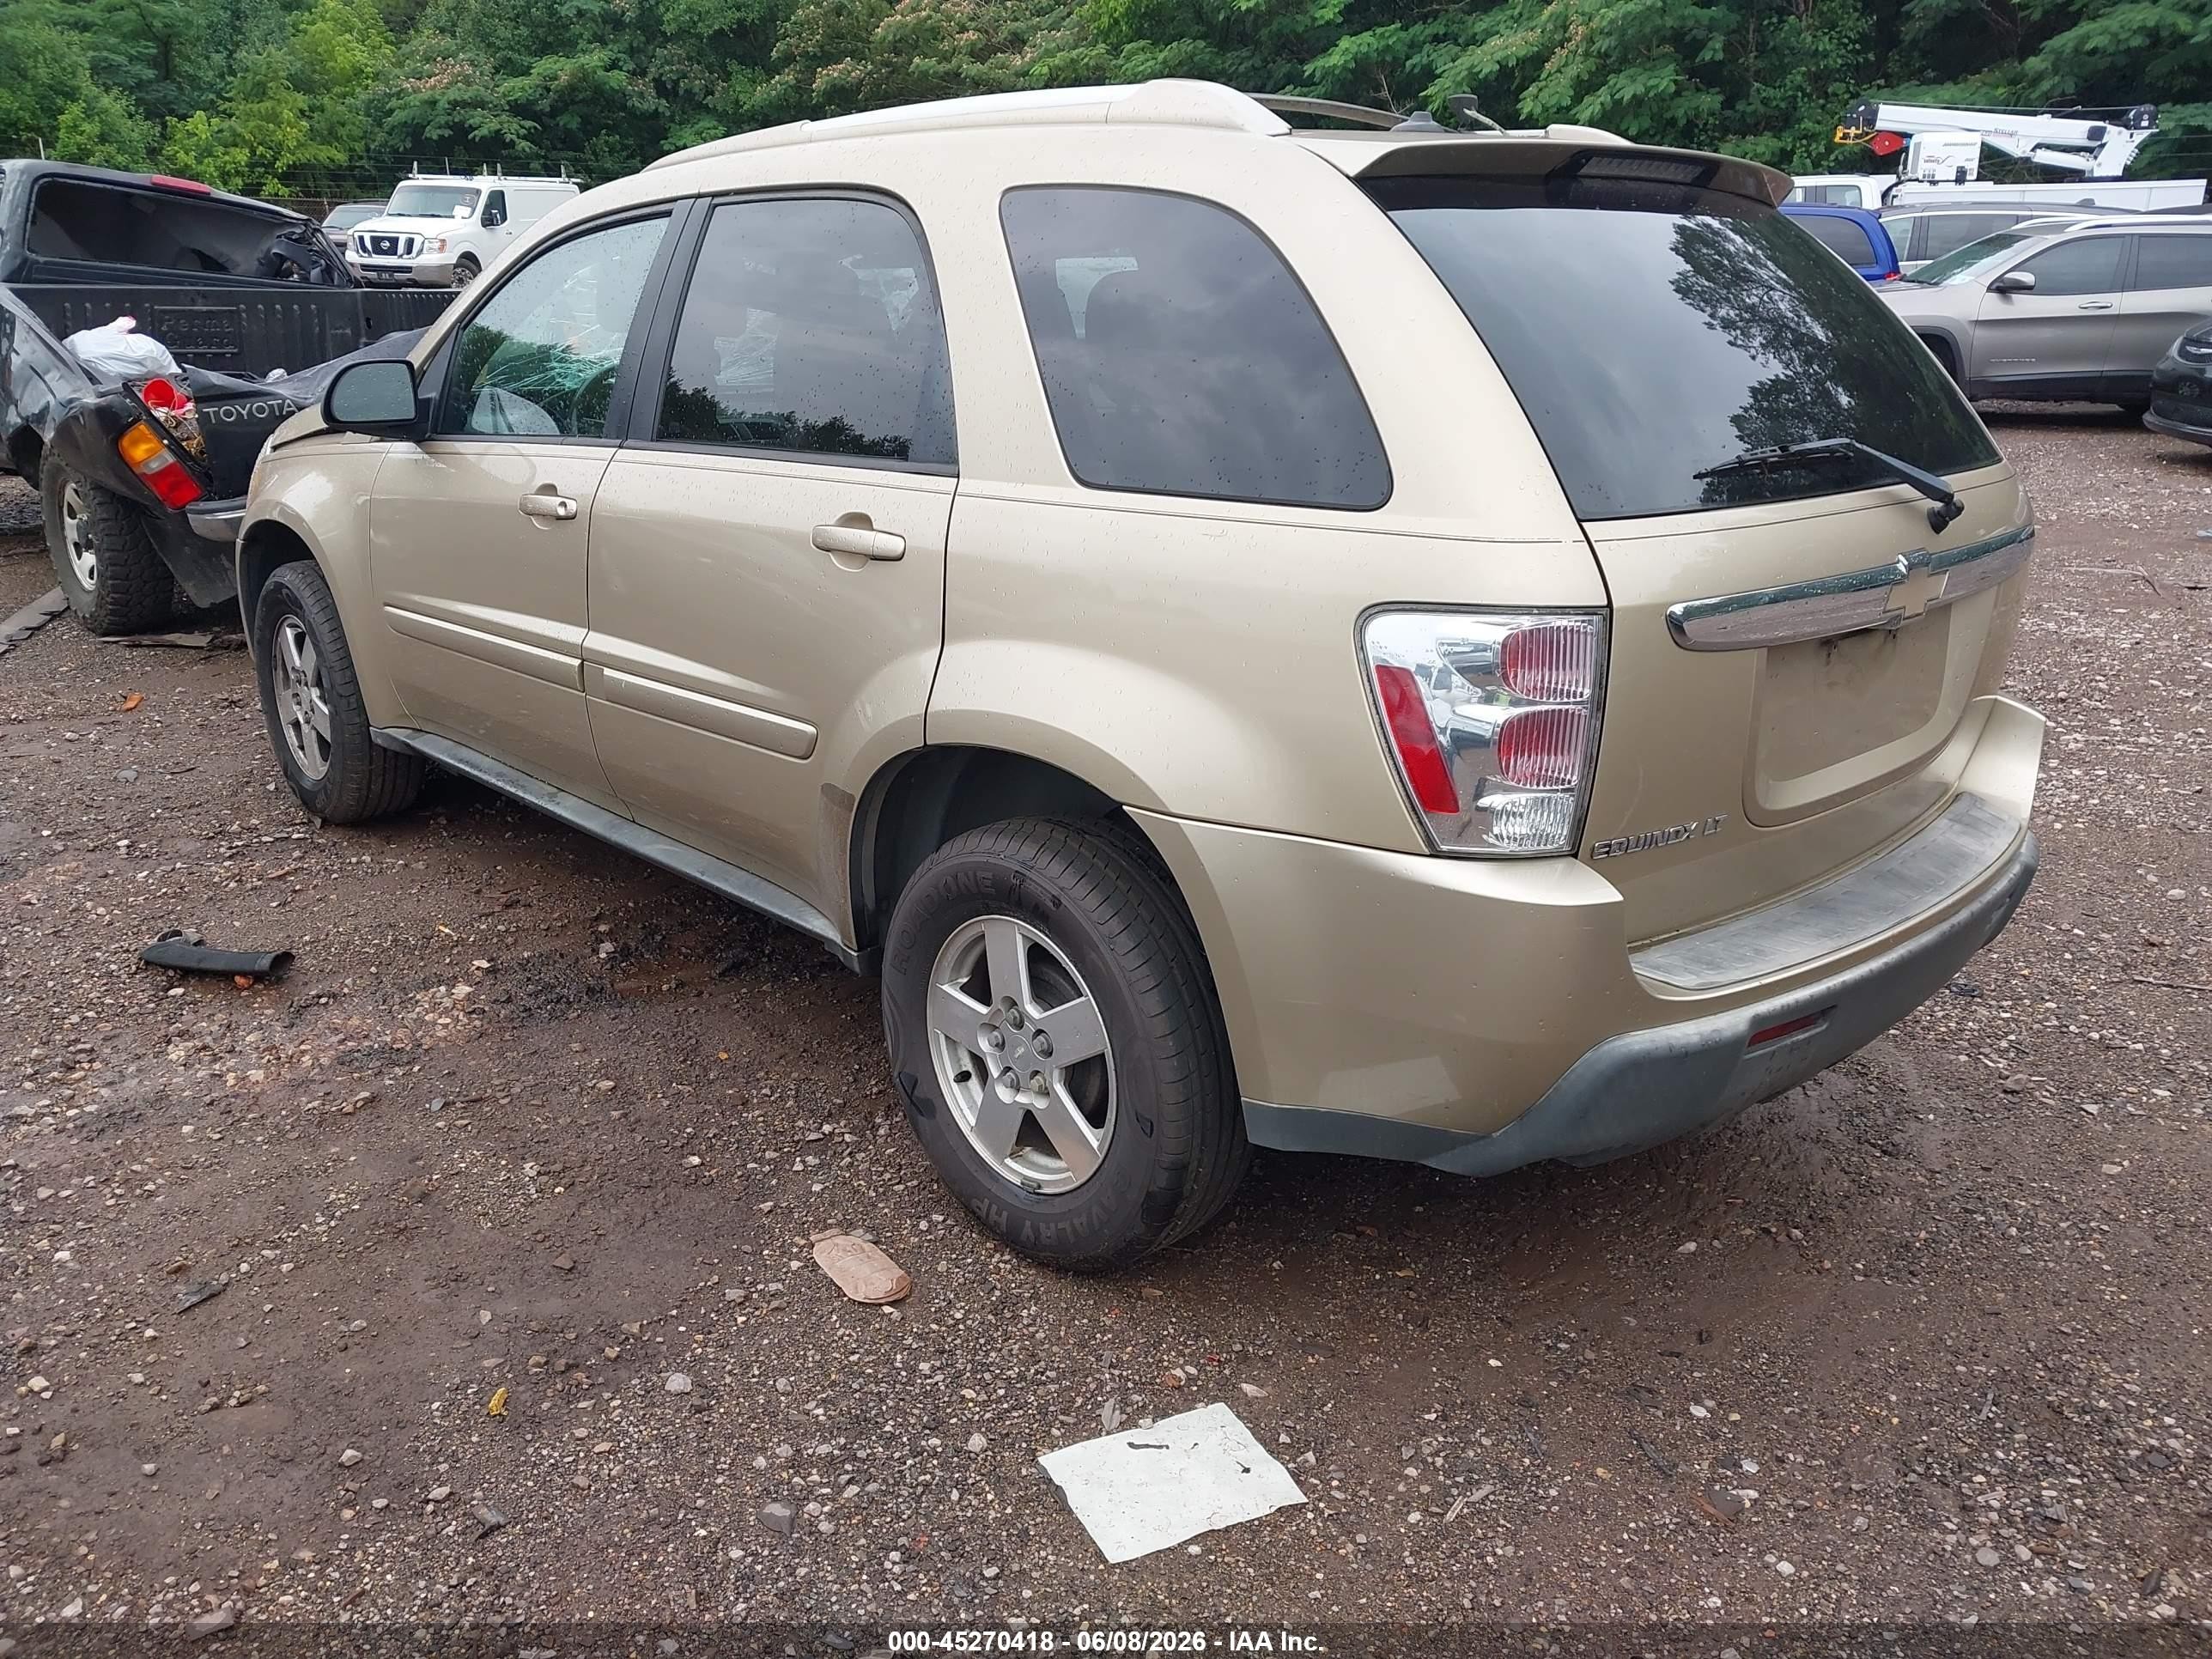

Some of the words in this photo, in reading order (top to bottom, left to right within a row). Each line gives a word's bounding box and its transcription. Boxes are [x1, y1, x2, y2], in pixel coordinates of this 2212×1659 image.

[202, 398, 301, 424] TOYOTA
[1591, 822, 1699, 860] EQUINOX
[1704, 814, 1729, 836] LT
